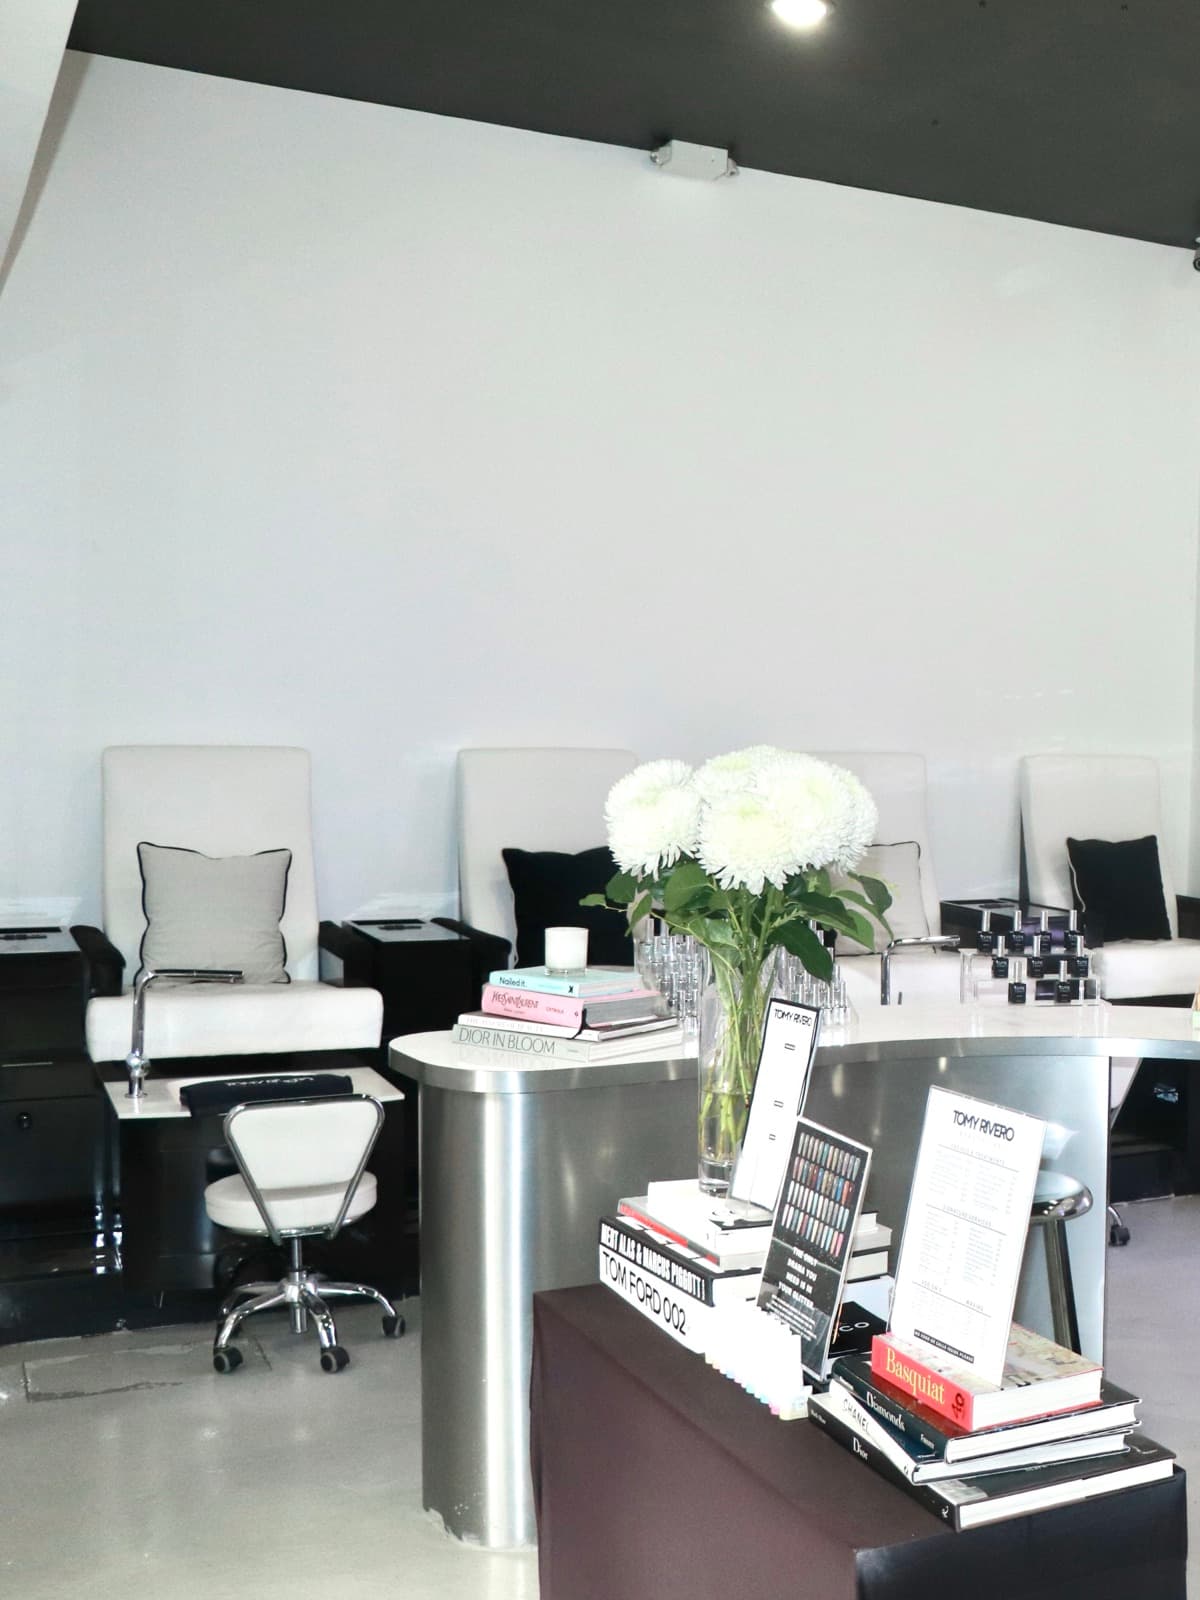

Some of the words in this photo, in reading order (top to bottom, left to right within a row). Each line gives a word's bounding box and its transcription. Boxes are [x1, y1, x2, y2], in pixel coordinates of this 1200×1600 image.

[775, 1008, 793, 1021] TOMY
[459, 1027, 491, 1046] DIOR
[492, 1035, 506, 1049] IN
[507, 1037, 555, 1055] BLOOM
[953, 1109, 980, 1131] TOMY
[979, 1118, 1015, 1142] RIVERO
[618, 1232, 636, 1261] ALAS
[642, 1246, 671, 1282] MARCUS
[602, 1250, 627, 1291] TOM
[629, 1269, 662, 1315] FORD
[662, 1296, 687, 1336] 002
[885, 1347, 946, 1406] Basquiat
[842, 1398, 870, 1433] CHANEL
[865, 1390, 906, 1433] Diamonds
[852, 1436, 869, 1461] Dior
